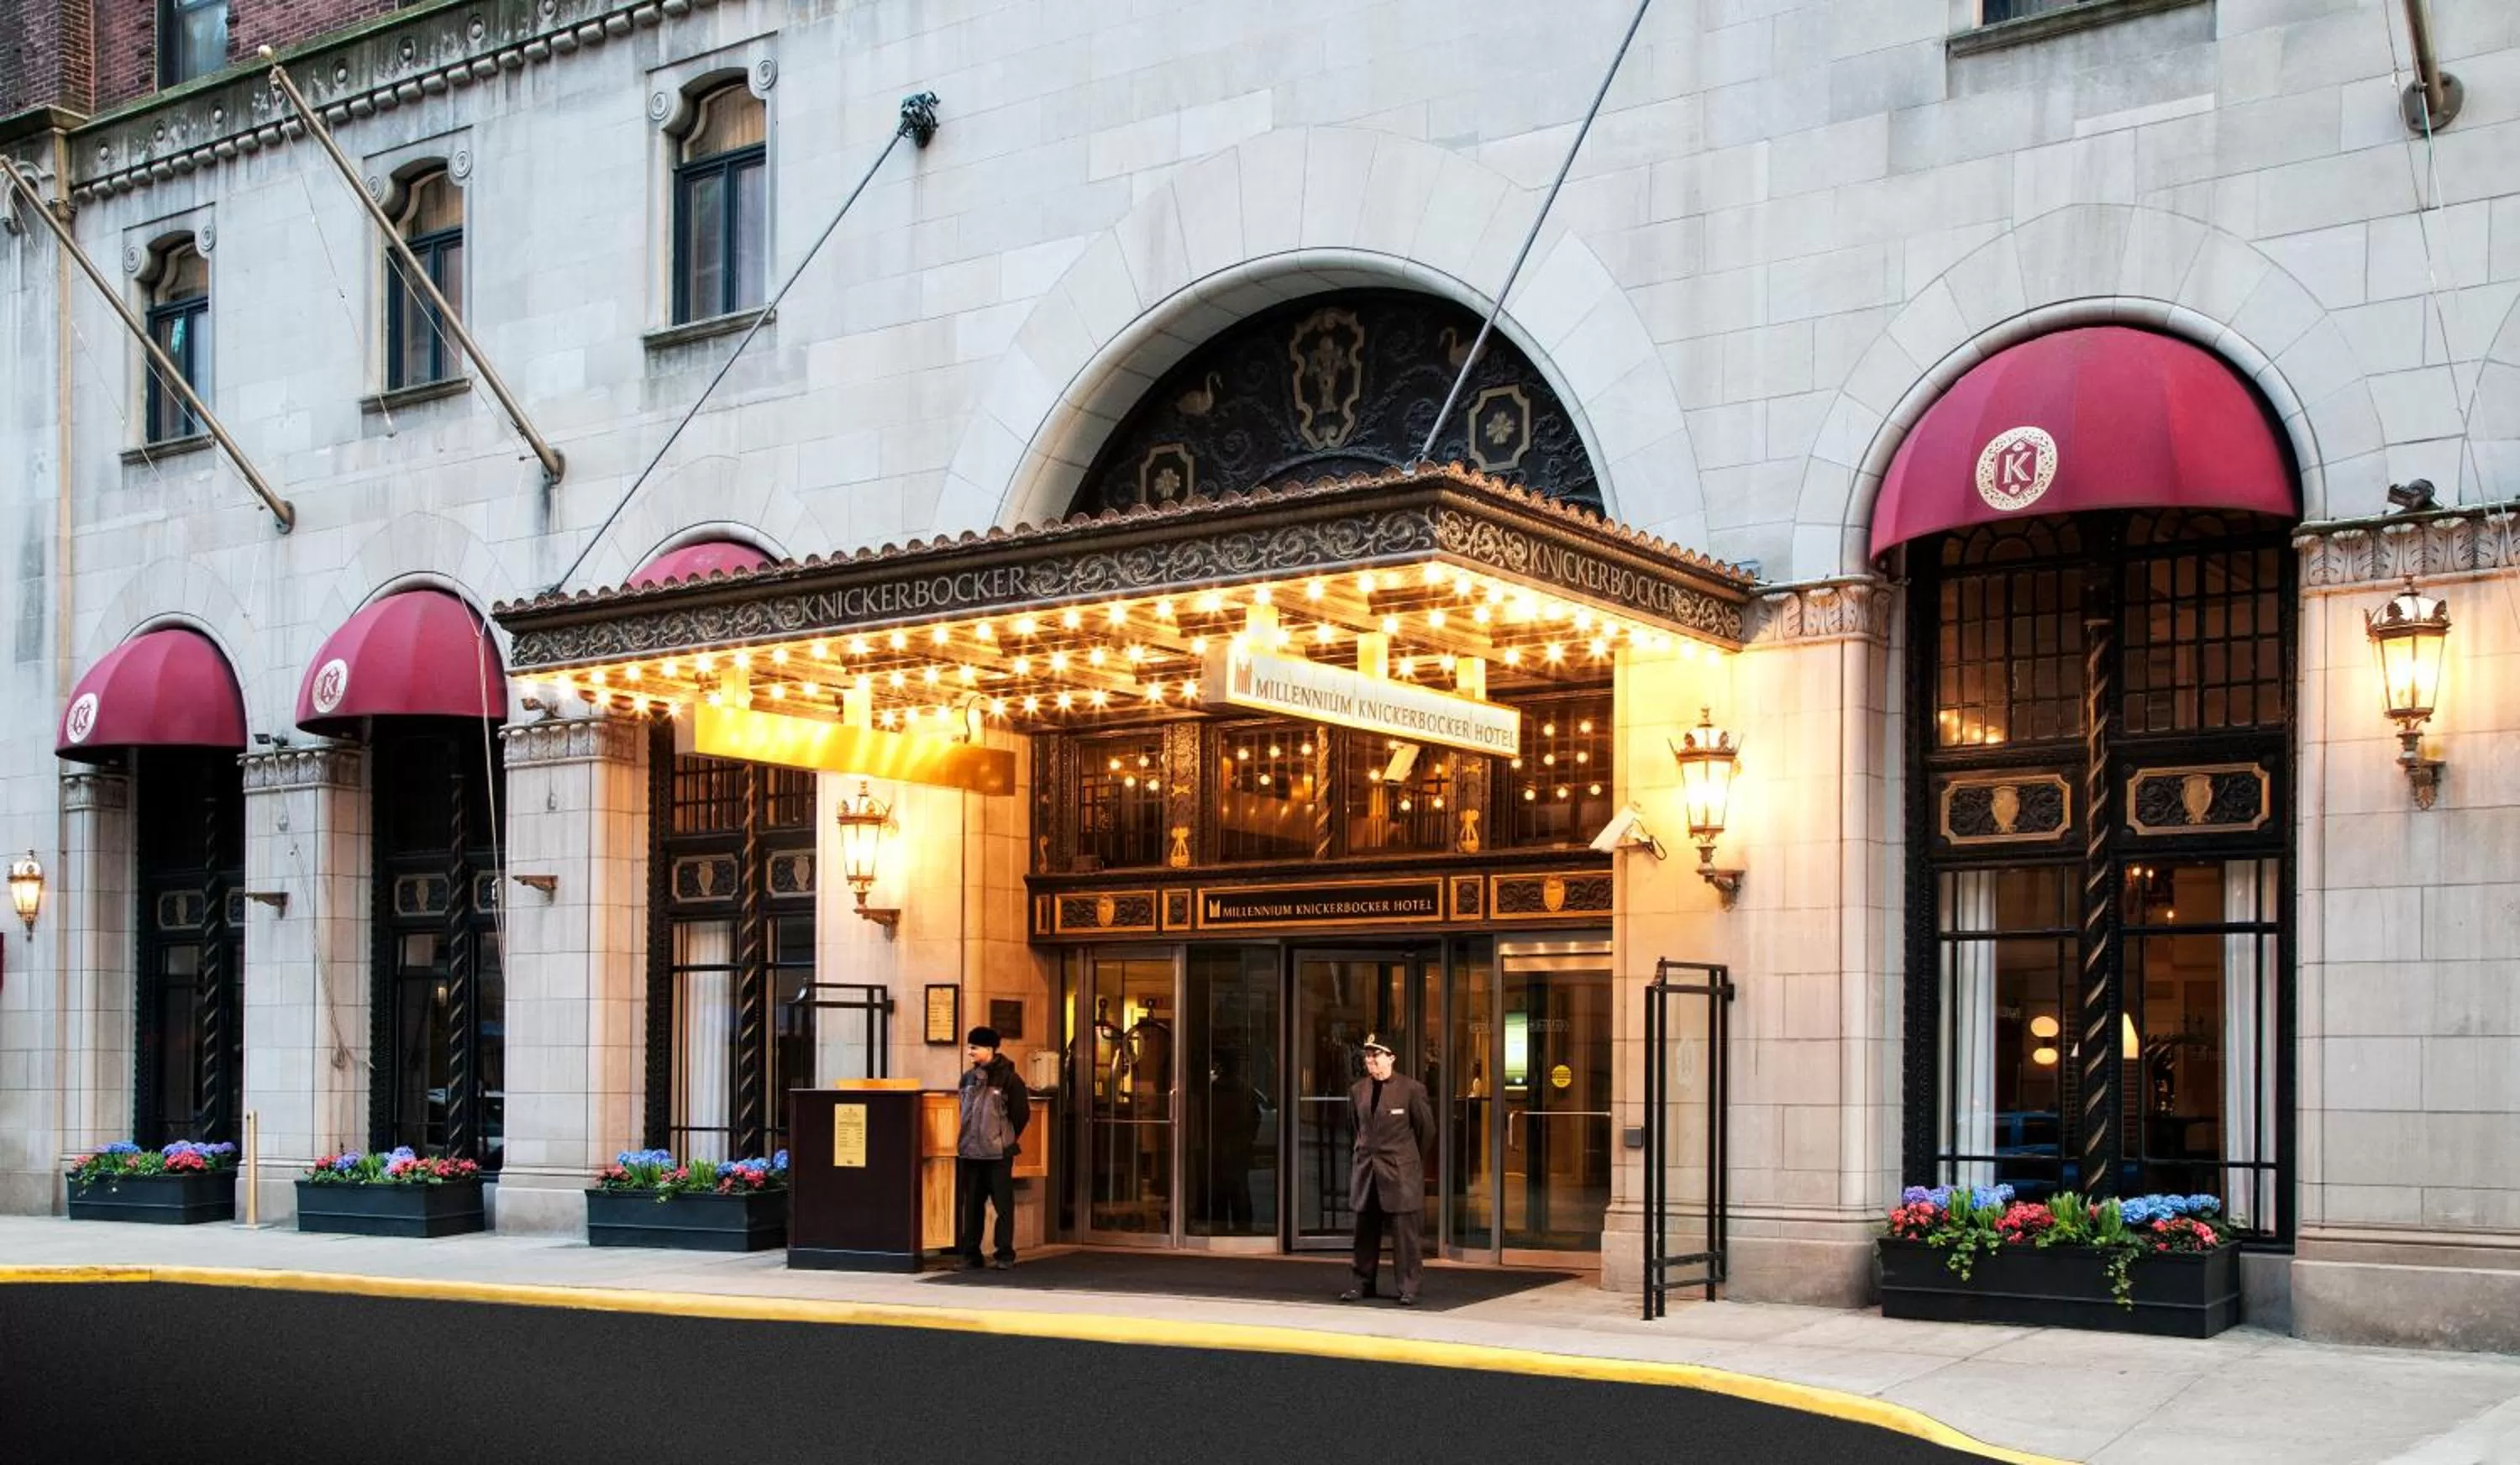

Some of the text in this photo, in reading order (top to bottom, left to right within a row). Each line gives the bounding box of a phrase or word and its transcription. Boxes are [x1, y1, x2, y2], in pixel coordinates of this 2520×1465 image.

[2003, 451, 2032, 484] K
[801, 565, 1028, 622] KNICKERBOCKER
[1529, 540, 1680, 612] KNICKERBOCKER
[323, 675, 337, 696] K
[1256, 677, 1515, 748] MILLENNIUM KNICKERBOCKER HOTEL
[1223, 899, 1433, 917] MILLENNIUM KNICKERBOCKER HOTEL
